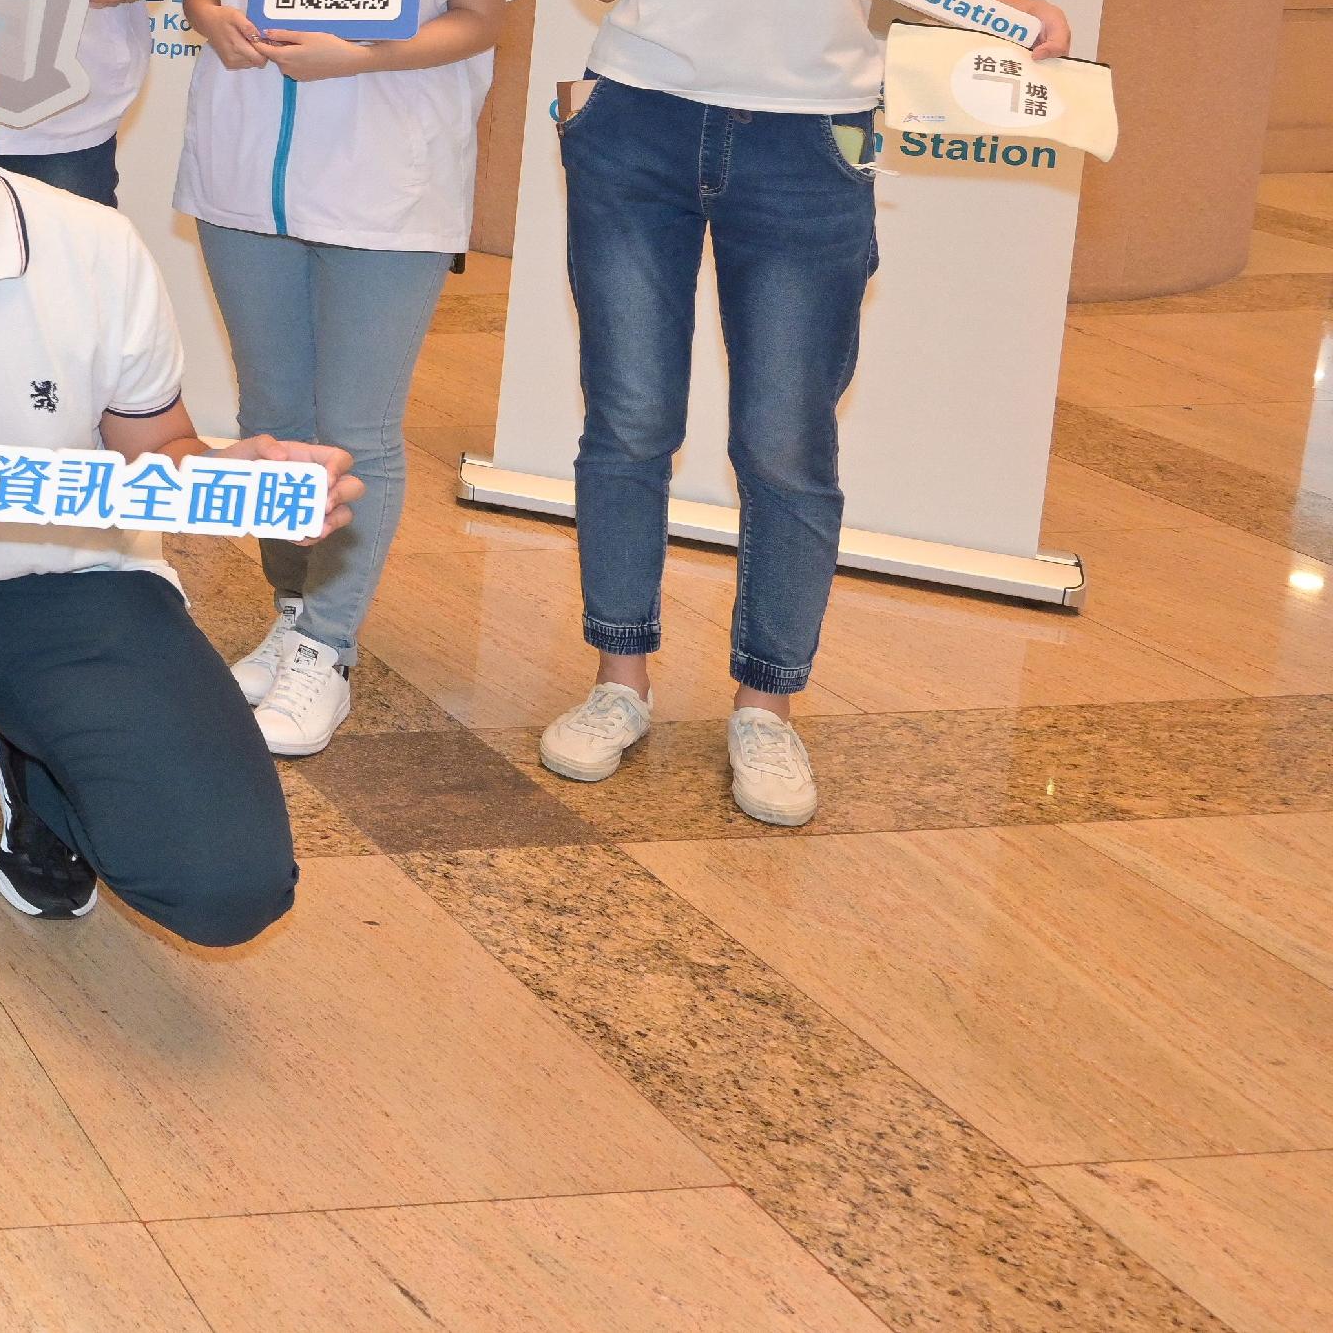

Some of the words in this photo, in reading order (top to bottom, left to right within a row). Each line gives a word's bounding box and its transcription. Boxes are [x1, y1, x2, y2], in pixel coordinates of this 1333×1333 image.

[974, 55, 1022, 77] 拾壹
[1024, 82, 1048, 117] 城話
[900, 131, 1057, 169] Station
